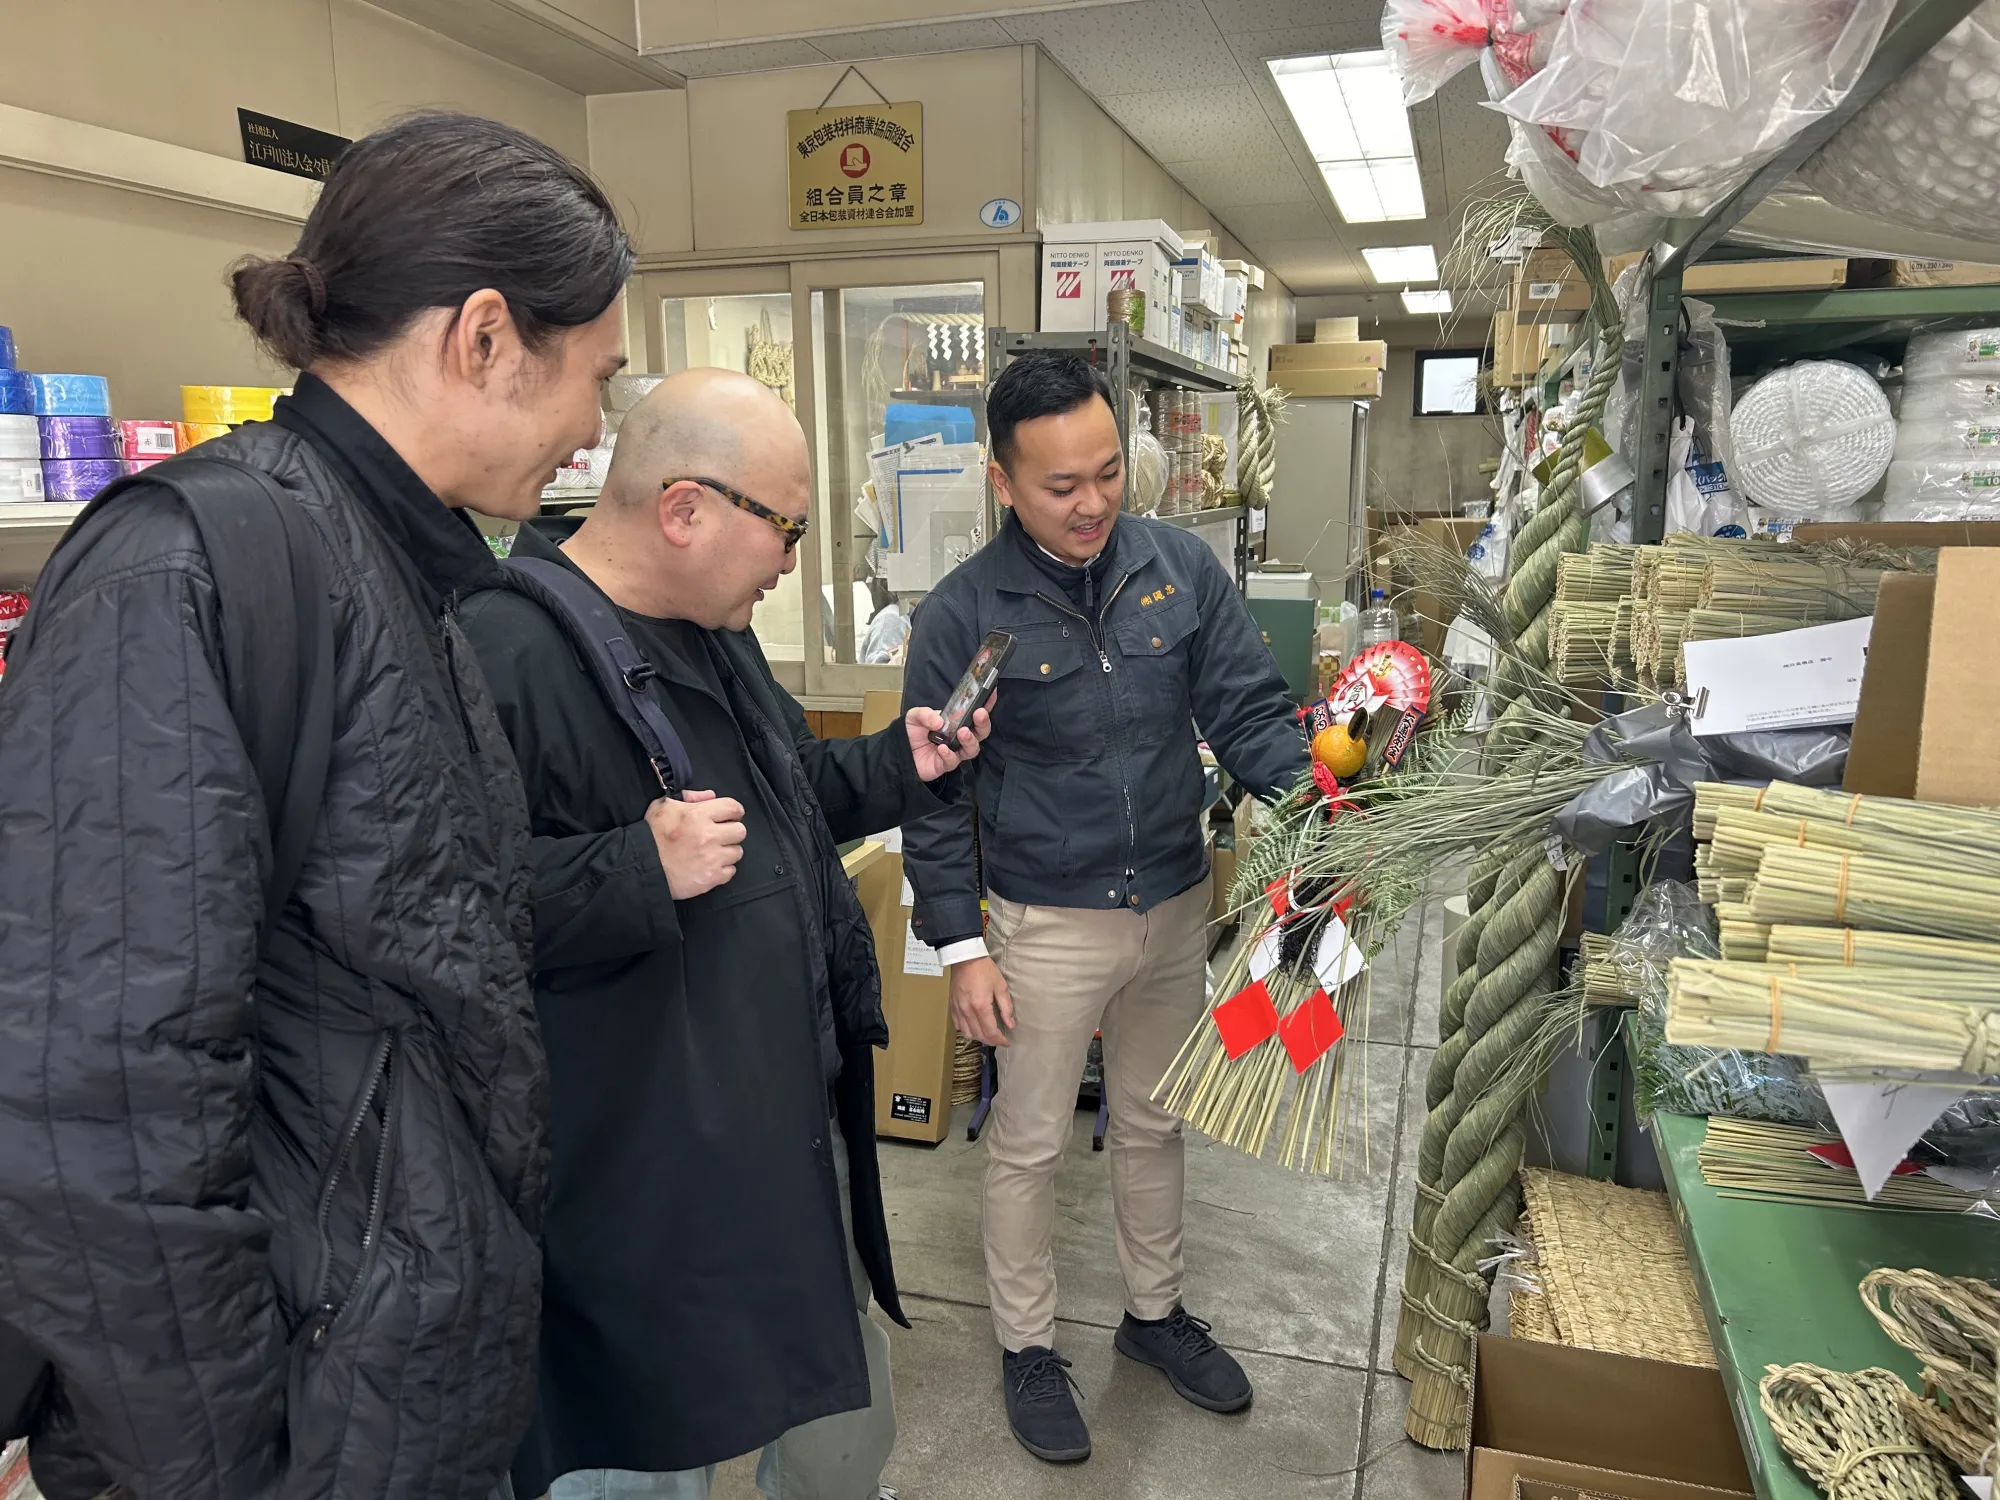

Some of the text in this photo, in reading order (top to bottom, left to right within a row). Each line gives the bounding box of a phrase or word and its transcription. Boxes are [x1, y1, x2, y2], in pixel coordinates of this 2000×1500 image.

[247, 121, 279, 140] 社団法人
[796, 115, 915, 159] 東京包装材料商業協同組合
[806, 182, 908, 207] 組合員之章
[799, 205, 914, 223] 全日本包装資材連合会加盟
[1386, 711, 1416, 761] 交通安全
